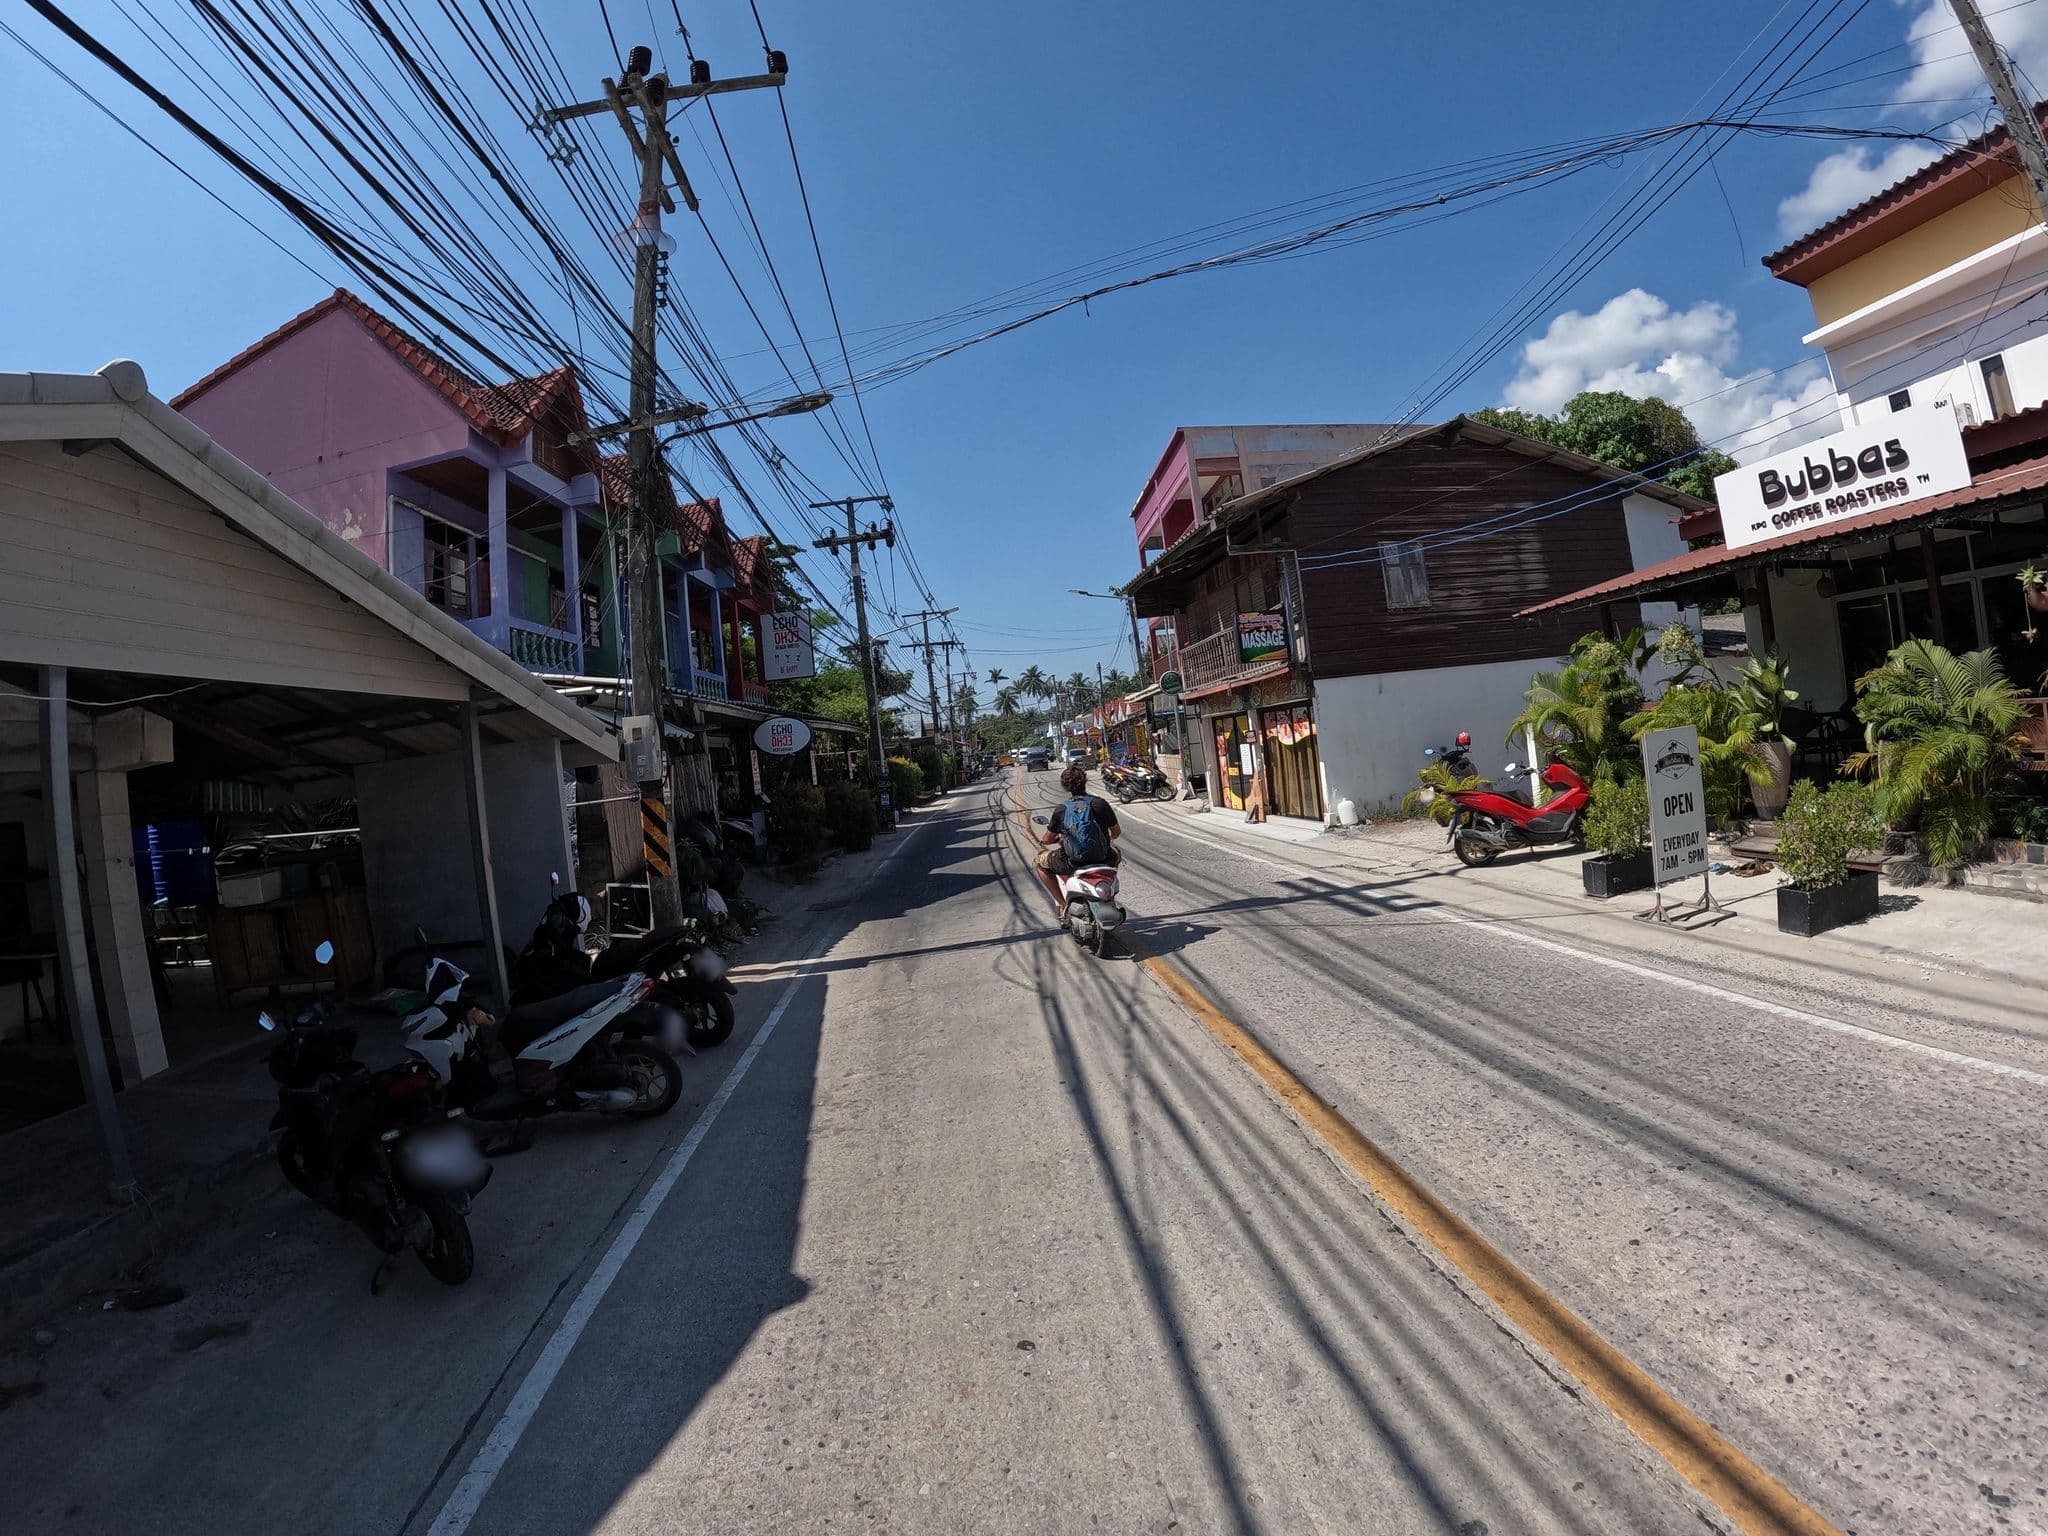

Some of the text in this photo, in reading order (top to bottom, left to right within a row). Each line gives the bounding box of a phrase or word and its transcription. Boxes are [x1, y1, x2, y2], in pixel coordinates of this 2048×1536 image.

[1758, 438, 1909, 506] Bubbas
[1772, 502, 1823, 527] COFFEE
[1825, 477, 1908, 511] ROASTERS
[1241, 630, 1285, 649] MASSAGE
[771, 723, 793, 735] ECHO
[1664, 792, 1694, 817] OPEN
[1663, 831, 1700, 853] EVERYDAY
[1661, 854, 1679, 872] 7AM
[537, 1026, 580, 1050] CLICK
